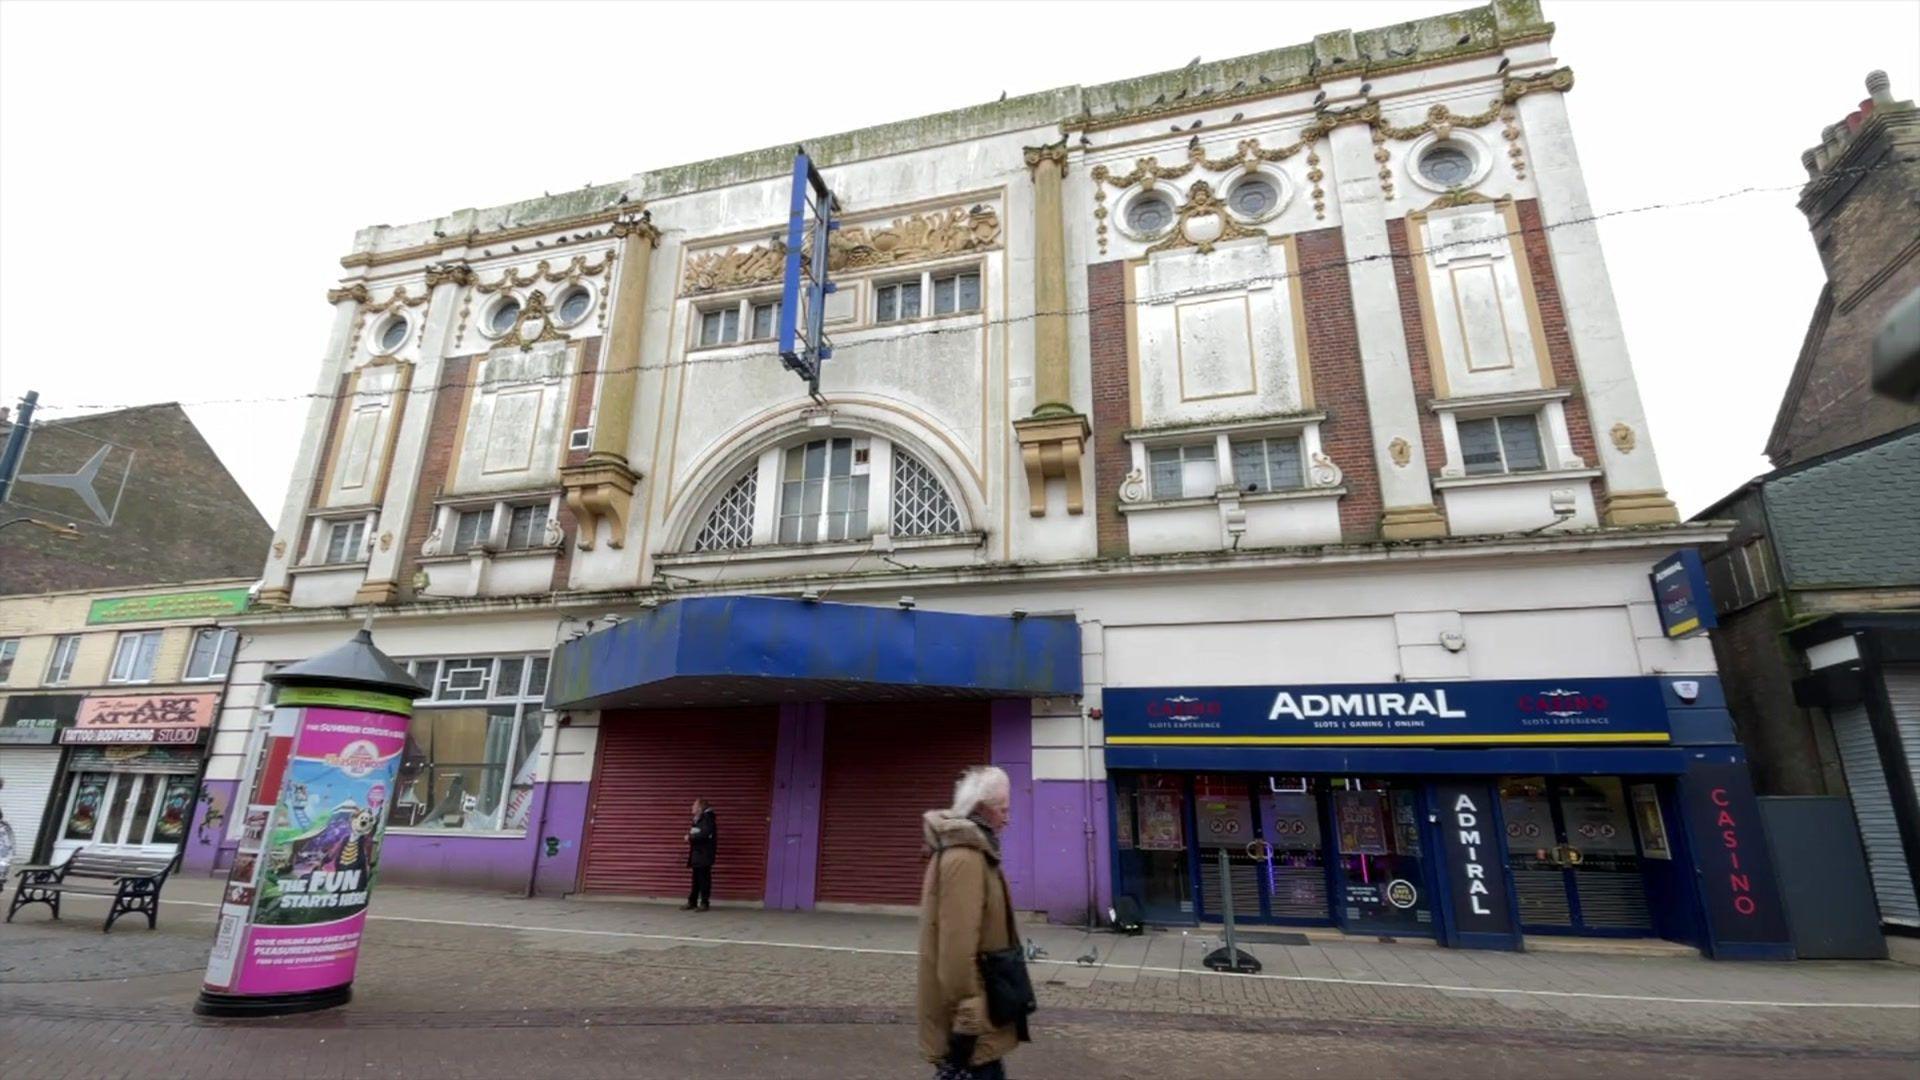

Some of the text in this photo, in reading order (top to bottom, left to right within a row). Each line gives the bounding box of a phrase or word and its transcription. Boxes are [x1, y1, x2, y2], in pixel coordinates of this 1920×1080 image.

[136, 698, 199, 712] ART
[1268, 689, 1467, 720] ADMIRAL
[1519, 696, 1608, 712] CASINO
[88, 710, 197, 724] ATTACK
[1522, 717, 1609, 726] SLOTS EXPERIENCE
[158, 728, 196, 742] STUDIO
[1455, 793, 1491, 914] ADMIRAL
[1711, 788, 1755, 914] CASINO
[277, 869, 361, 892] THE FUN
[280, 893, 339, 908] STARTS
